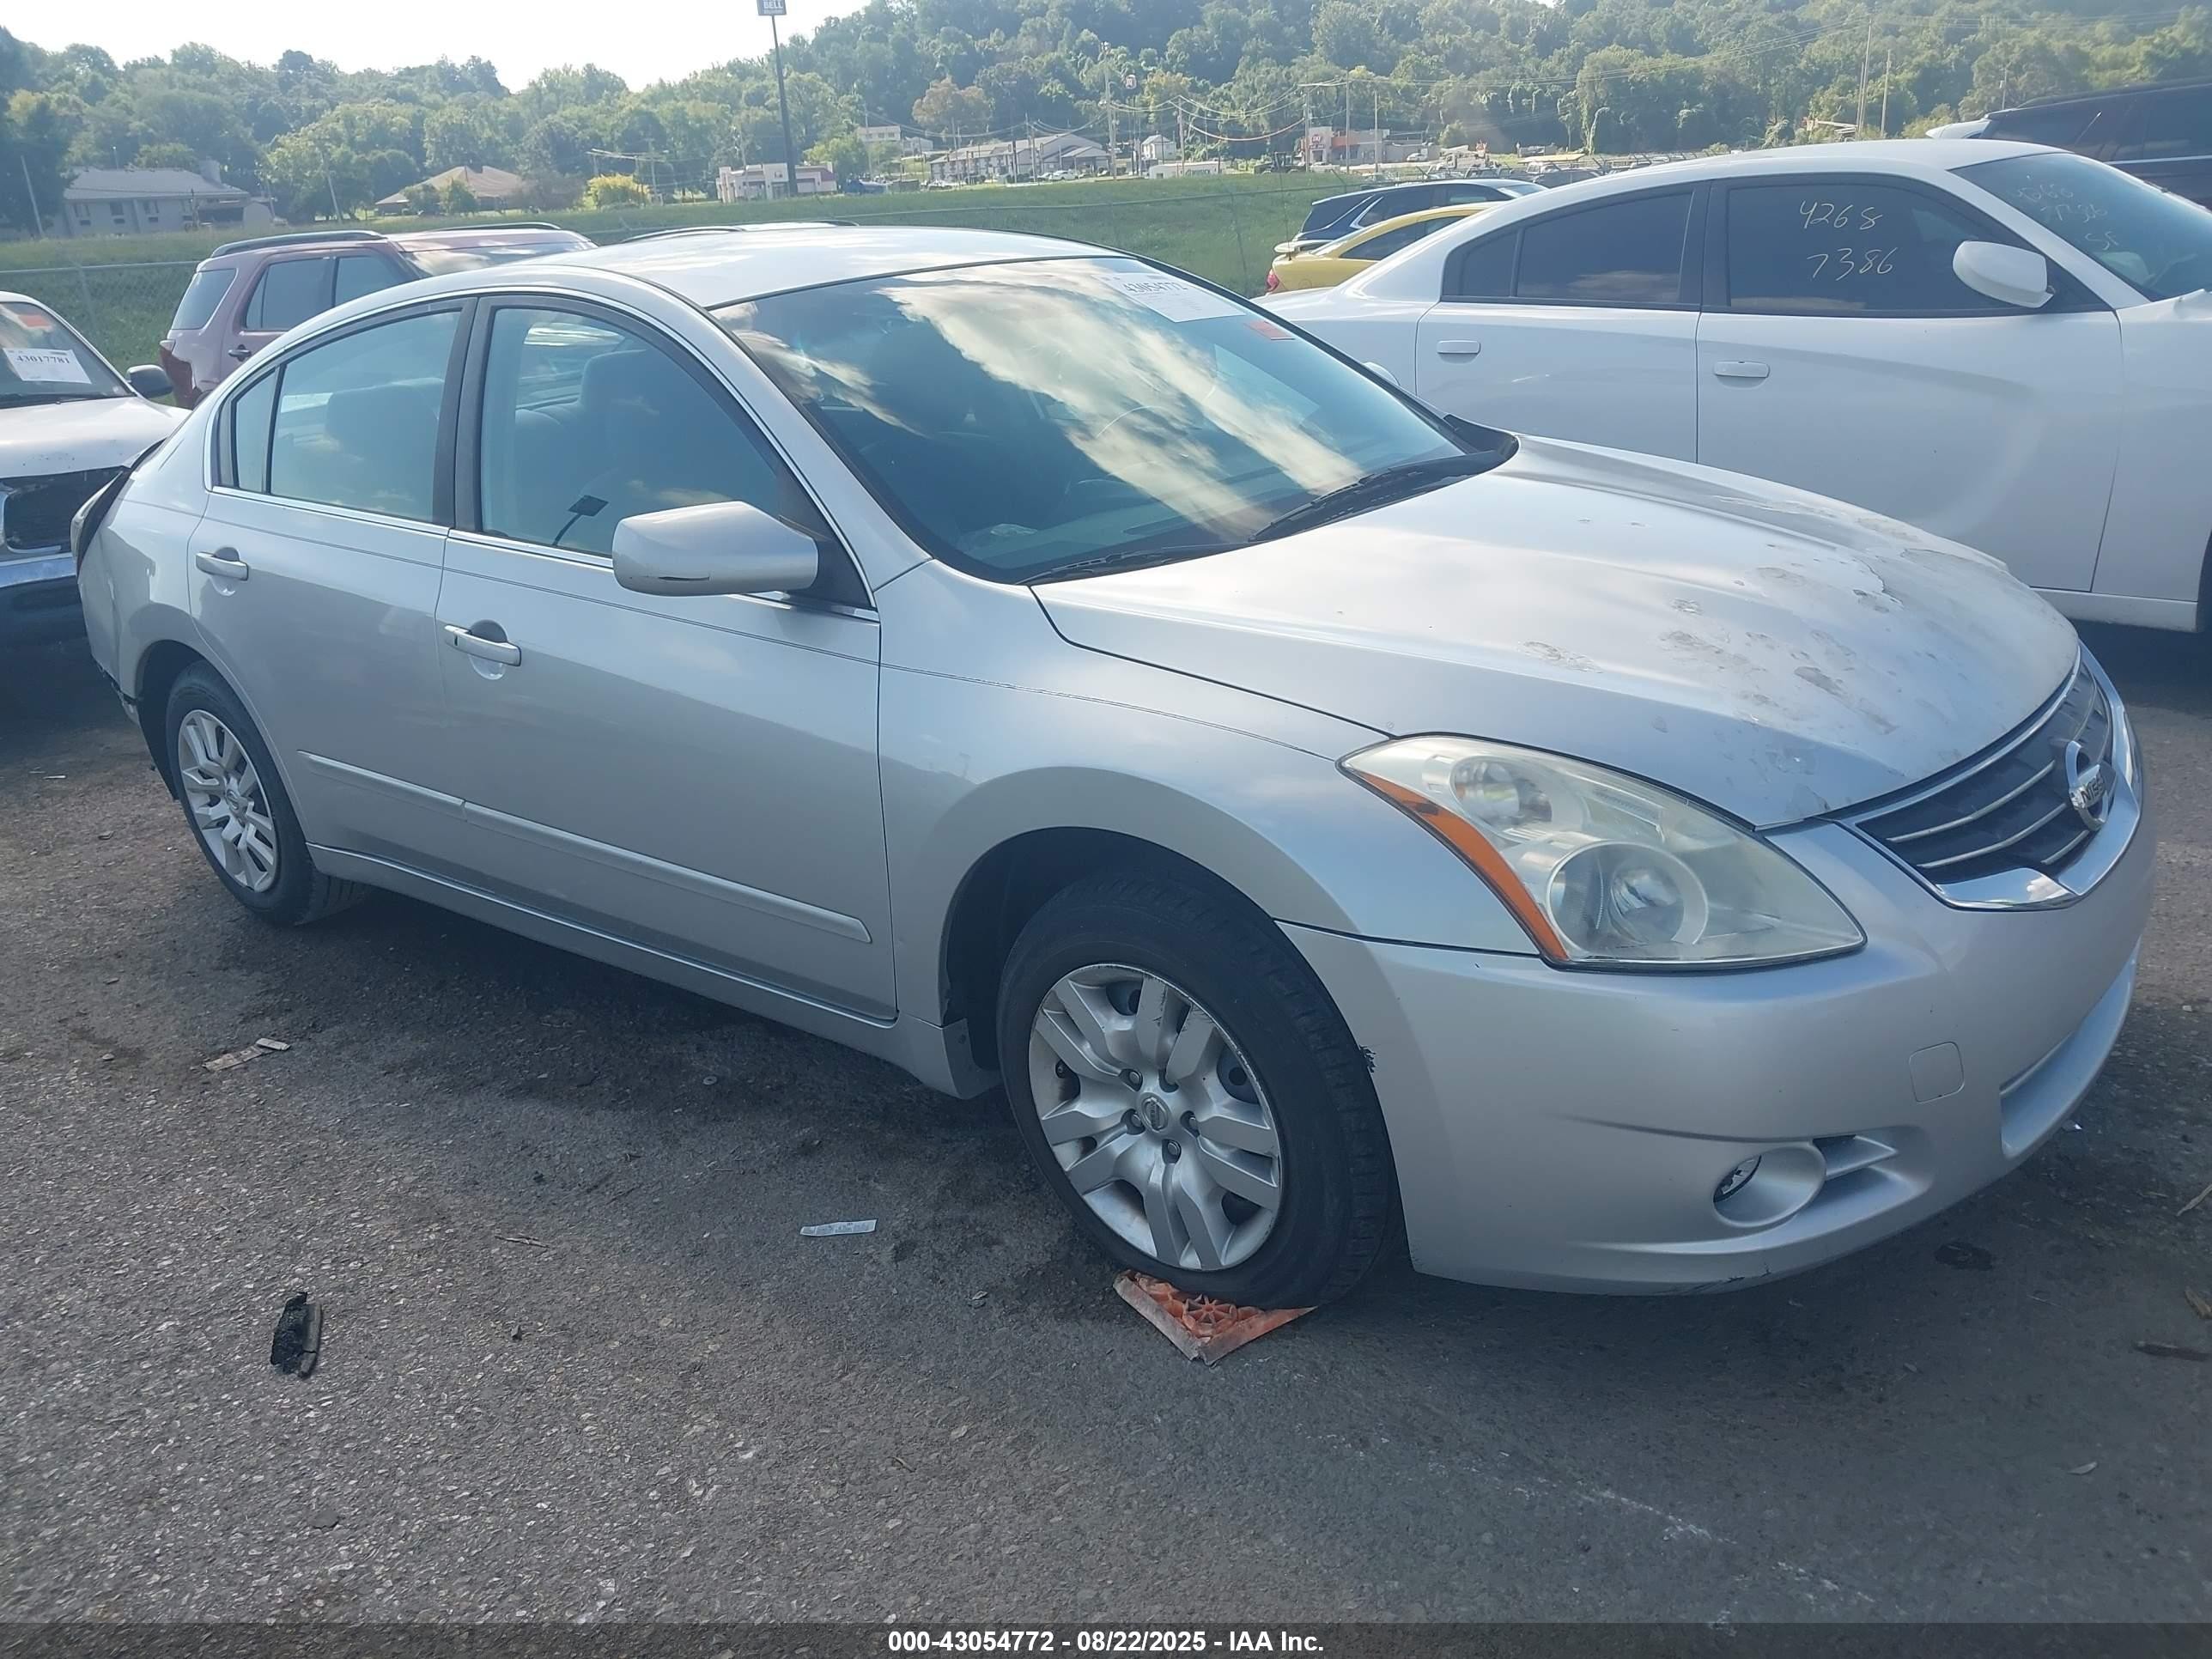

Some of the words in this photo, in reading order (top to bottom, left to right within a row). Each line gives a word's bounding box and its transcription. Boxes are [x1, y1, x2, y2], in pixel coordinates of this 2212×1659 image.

[1799, 200, 1883, 230] 4268
[1806, 246, 1899, 281] 7386
[16, 355, 70, 364] 43017781
